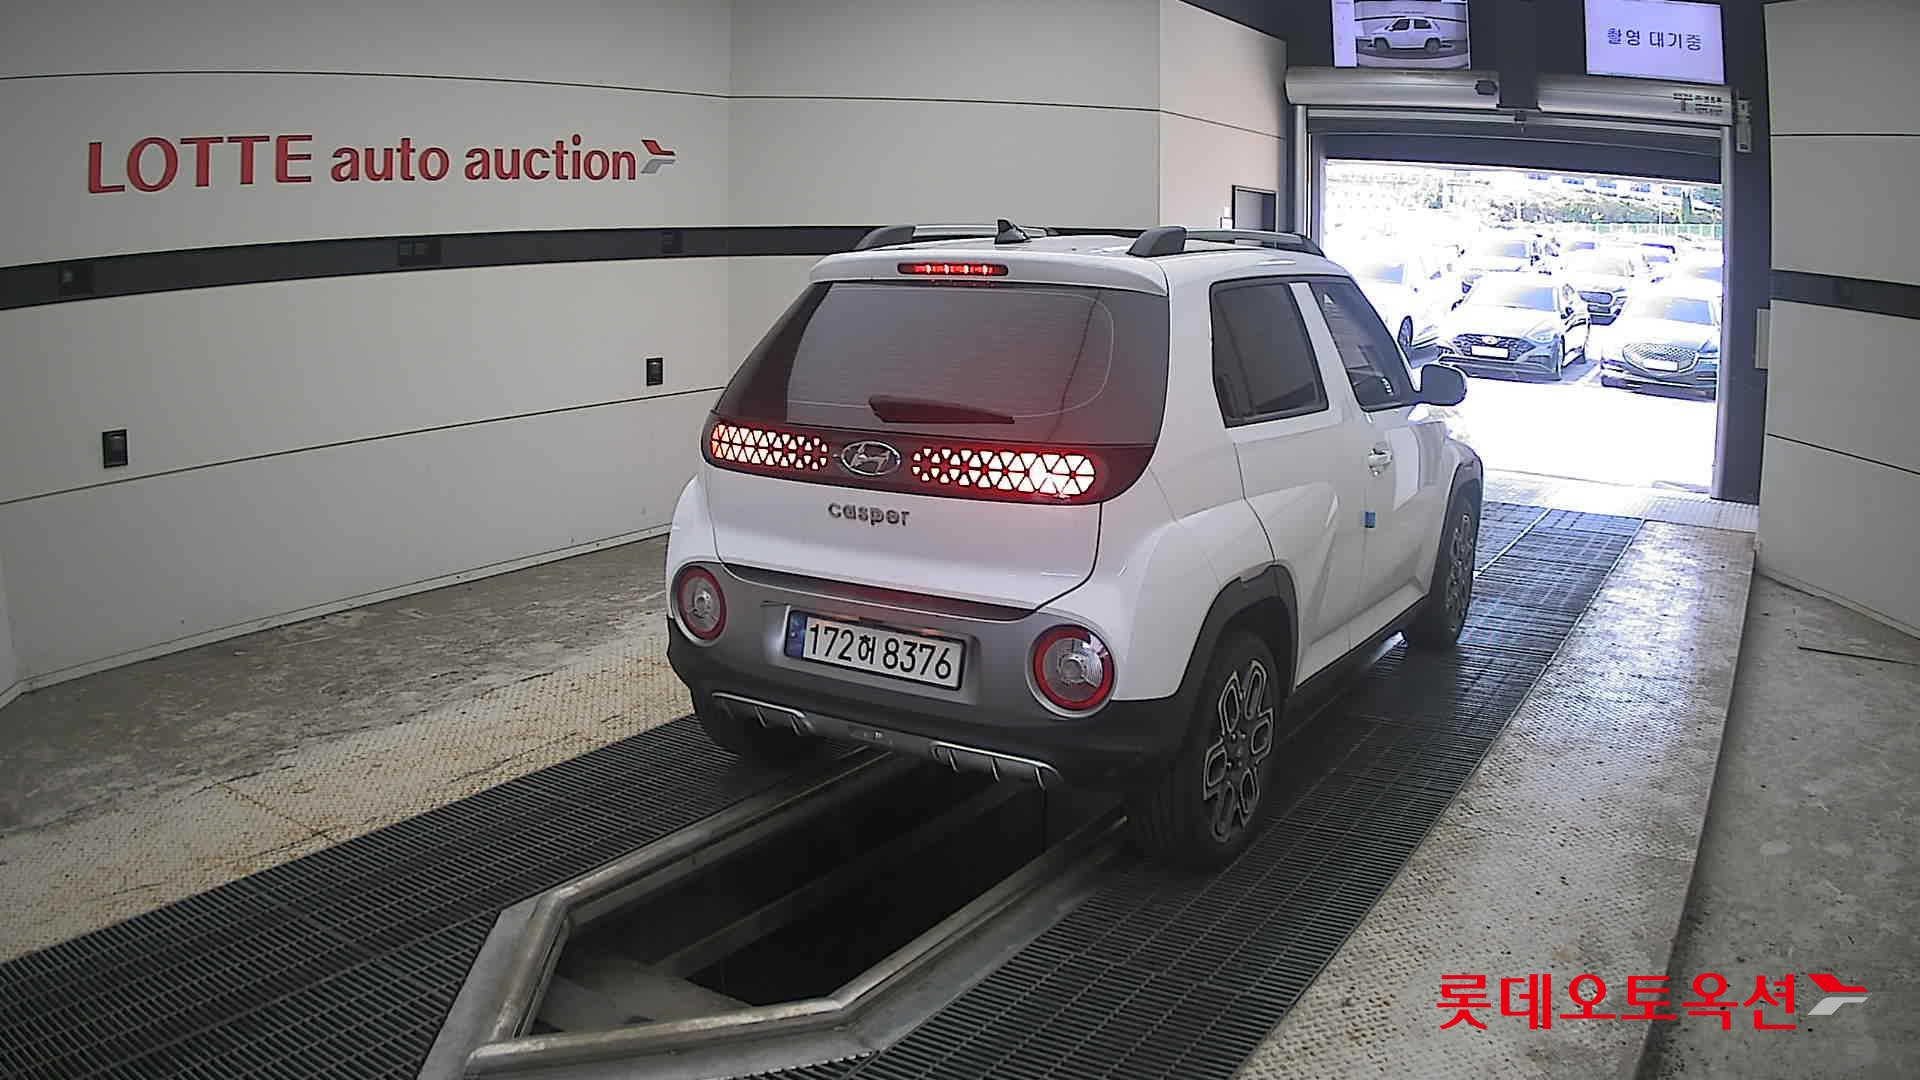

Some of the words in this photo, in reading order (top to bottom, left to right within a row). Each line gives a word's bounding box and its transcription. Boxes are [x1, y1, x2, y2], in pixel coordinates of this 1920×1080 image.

[88, 134, 312, 193] LOTTE
[331, 137, 450, 182] auto
[464, 135, 637, 181] auction
[828, 502, 910, 526] casper
